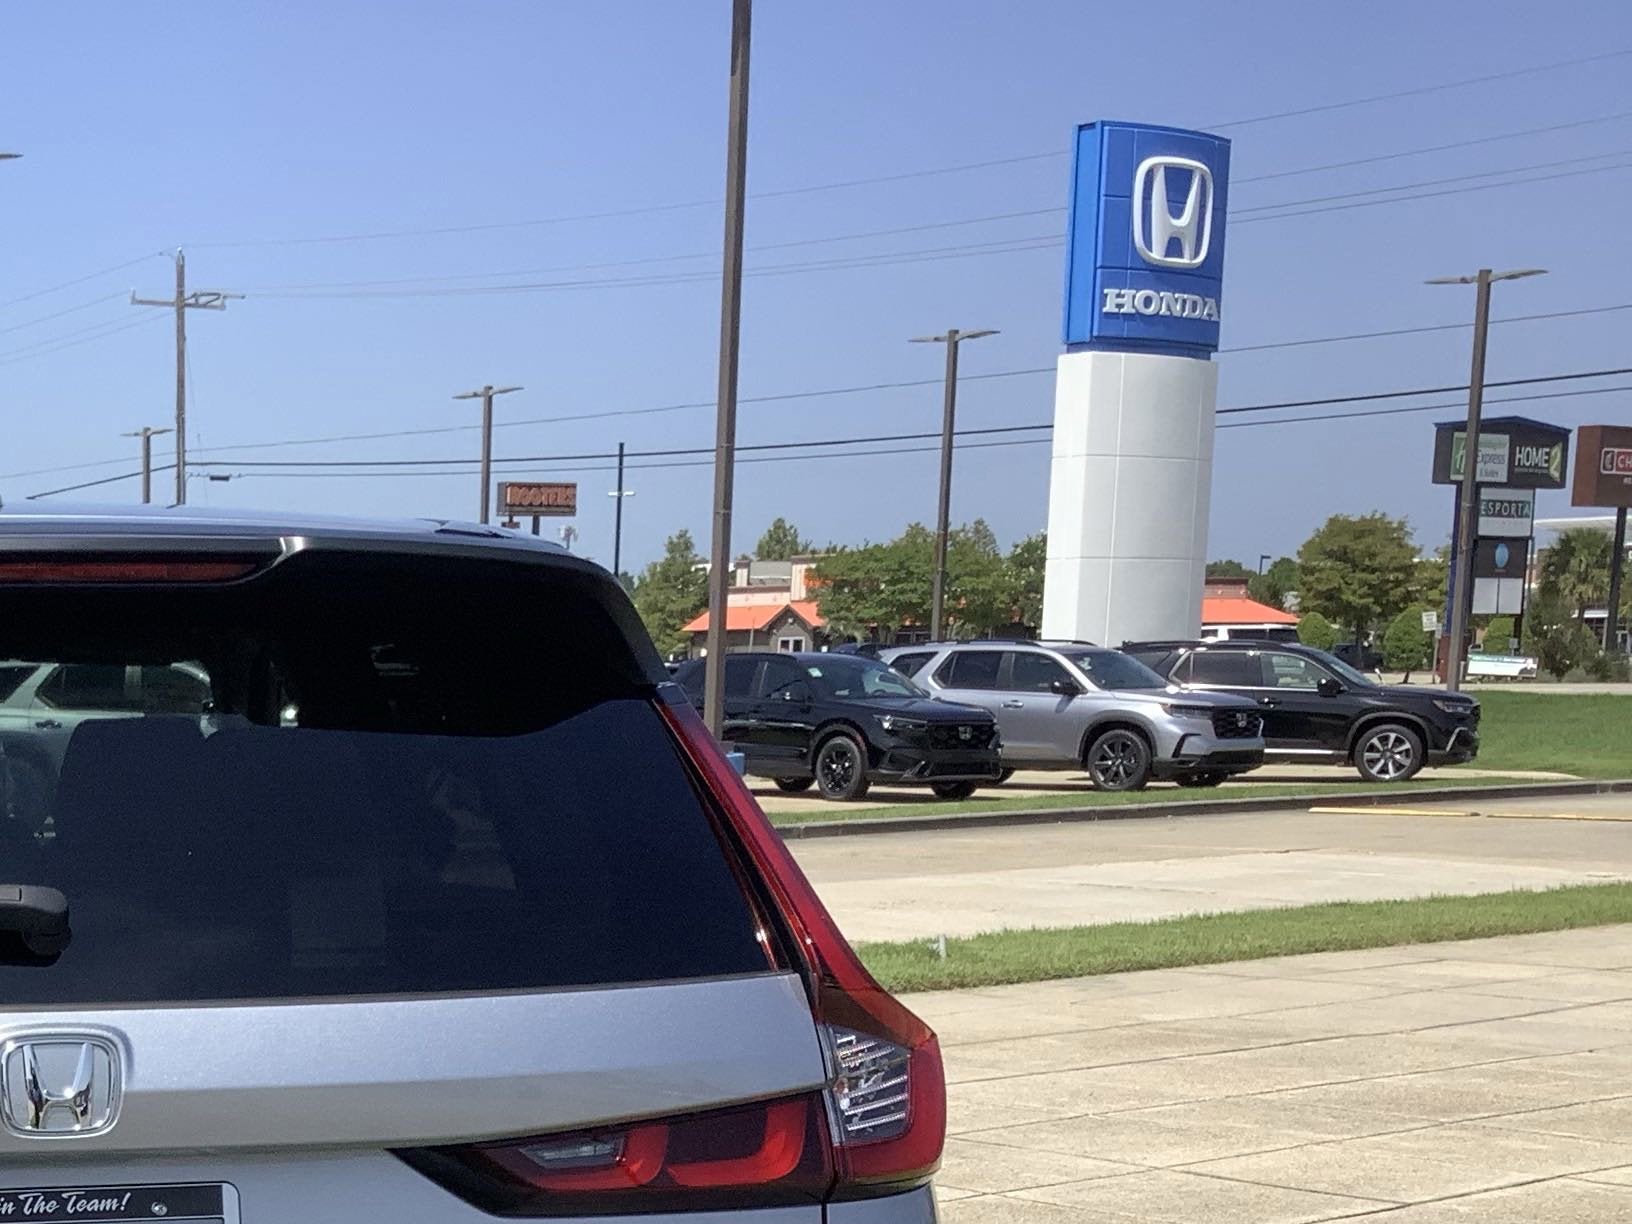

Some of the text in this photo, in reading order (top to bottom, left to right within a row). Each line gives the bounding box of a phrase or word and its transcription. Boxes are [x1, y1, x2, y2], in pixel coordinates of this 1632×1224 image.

[1102, 288, 1221, 322] HONDA
[1481, 500, 1531, 518] ESPORTA
[17, 1192, 60, 1216] The
[61, 1191, 132, 1215] Team!
